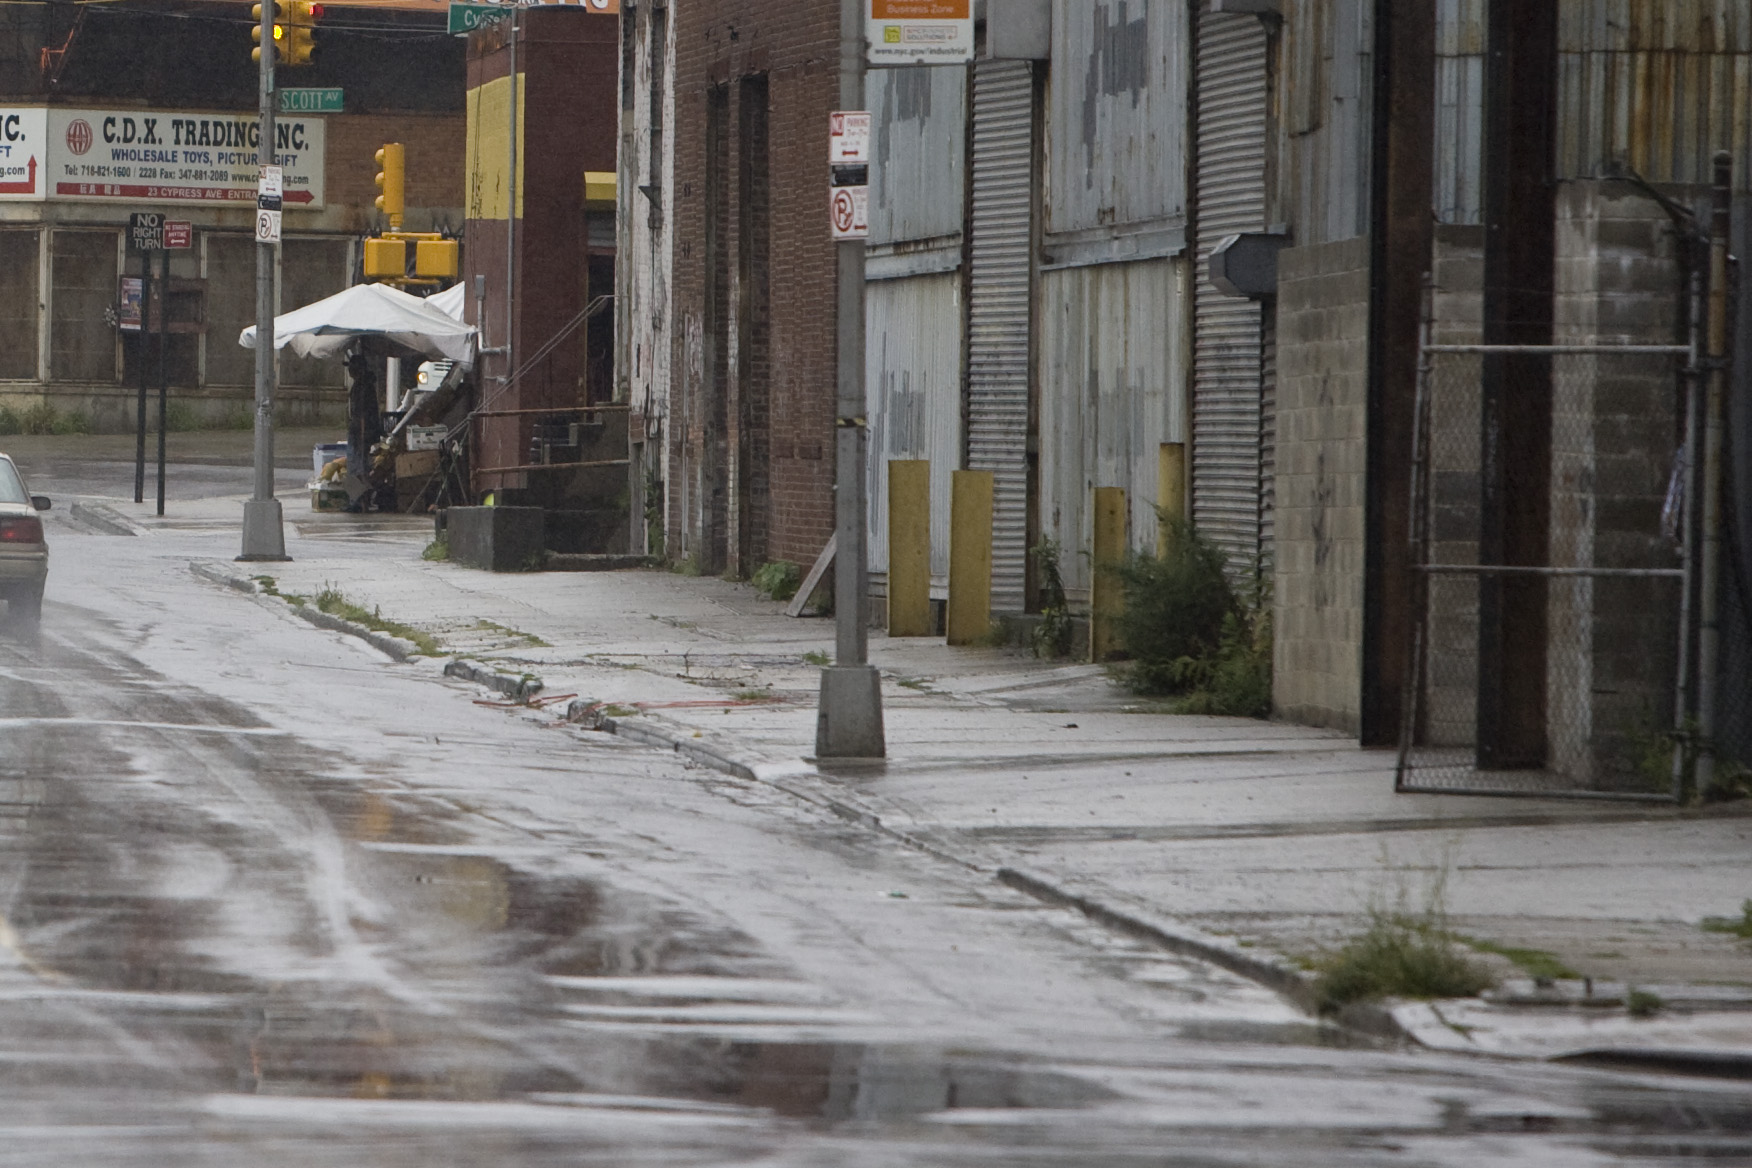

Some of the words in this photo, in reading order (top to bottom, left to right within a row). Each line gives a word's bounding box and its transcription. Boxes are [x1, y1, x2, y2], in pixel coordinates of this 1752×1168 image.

[886, 4, 929, 14] Business
[931, 4, 954, 13] Zone
[281, 91, 324, 109] SCOTT
[325, 91, 339, 102] AV
[103, 116, 163, 145] C.D.X.
[171, 118, 260, 148] TRADING
[276, 122, 309, 151] NC.
[111, 148, 178, 164] WHOLESALE
[183, 150, 213, 167] TOYS,
[217, 153, 259, 166] PICTUR
[273, 154, 298, 167] GIFT
[64, 164, 78, 176] Tel:
[138, 167, 157, 179] 2228
[159, 168, 176, 180] Fax:
[231, 172, 309, 187] www.cng.com
[147, 186, 158, 196] 23
[160, 187, 202, 198] CYPRESS
[204, 189, 225, 199] AVE.
[227, 190, 259, 201] ENTRA
[137, 214, 159, 227] NO
[133, 227, 163, 238] RIGHT
[134, 238, 161, 249] TURN
